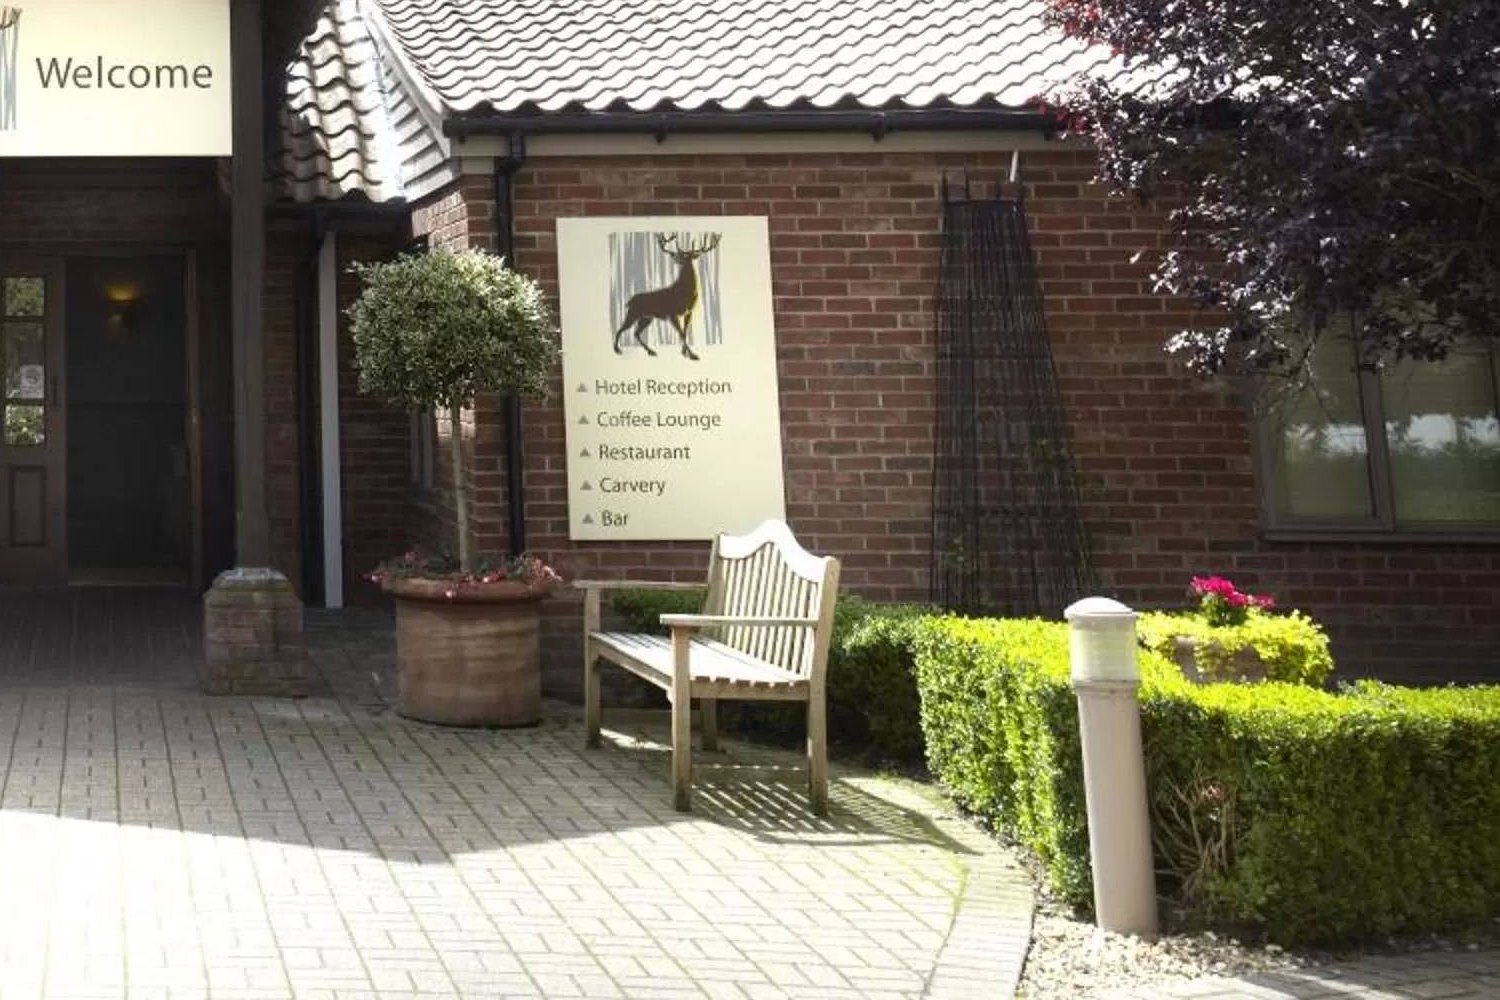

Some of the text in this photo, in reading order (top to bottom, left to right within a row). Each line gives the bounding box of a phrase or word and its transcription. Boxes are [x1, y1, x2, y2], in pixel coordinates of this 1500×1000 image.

[35, 55, 213, 89] Welcome
[595, 378, 732, 398] Hotel Reception
[596, 411, 721, 430] Coffee Lounge
[598, 444, 691, 461] Restaurant
[599, 476, 665, 496] Carvery
[601, 510, 629, 527] Bar
